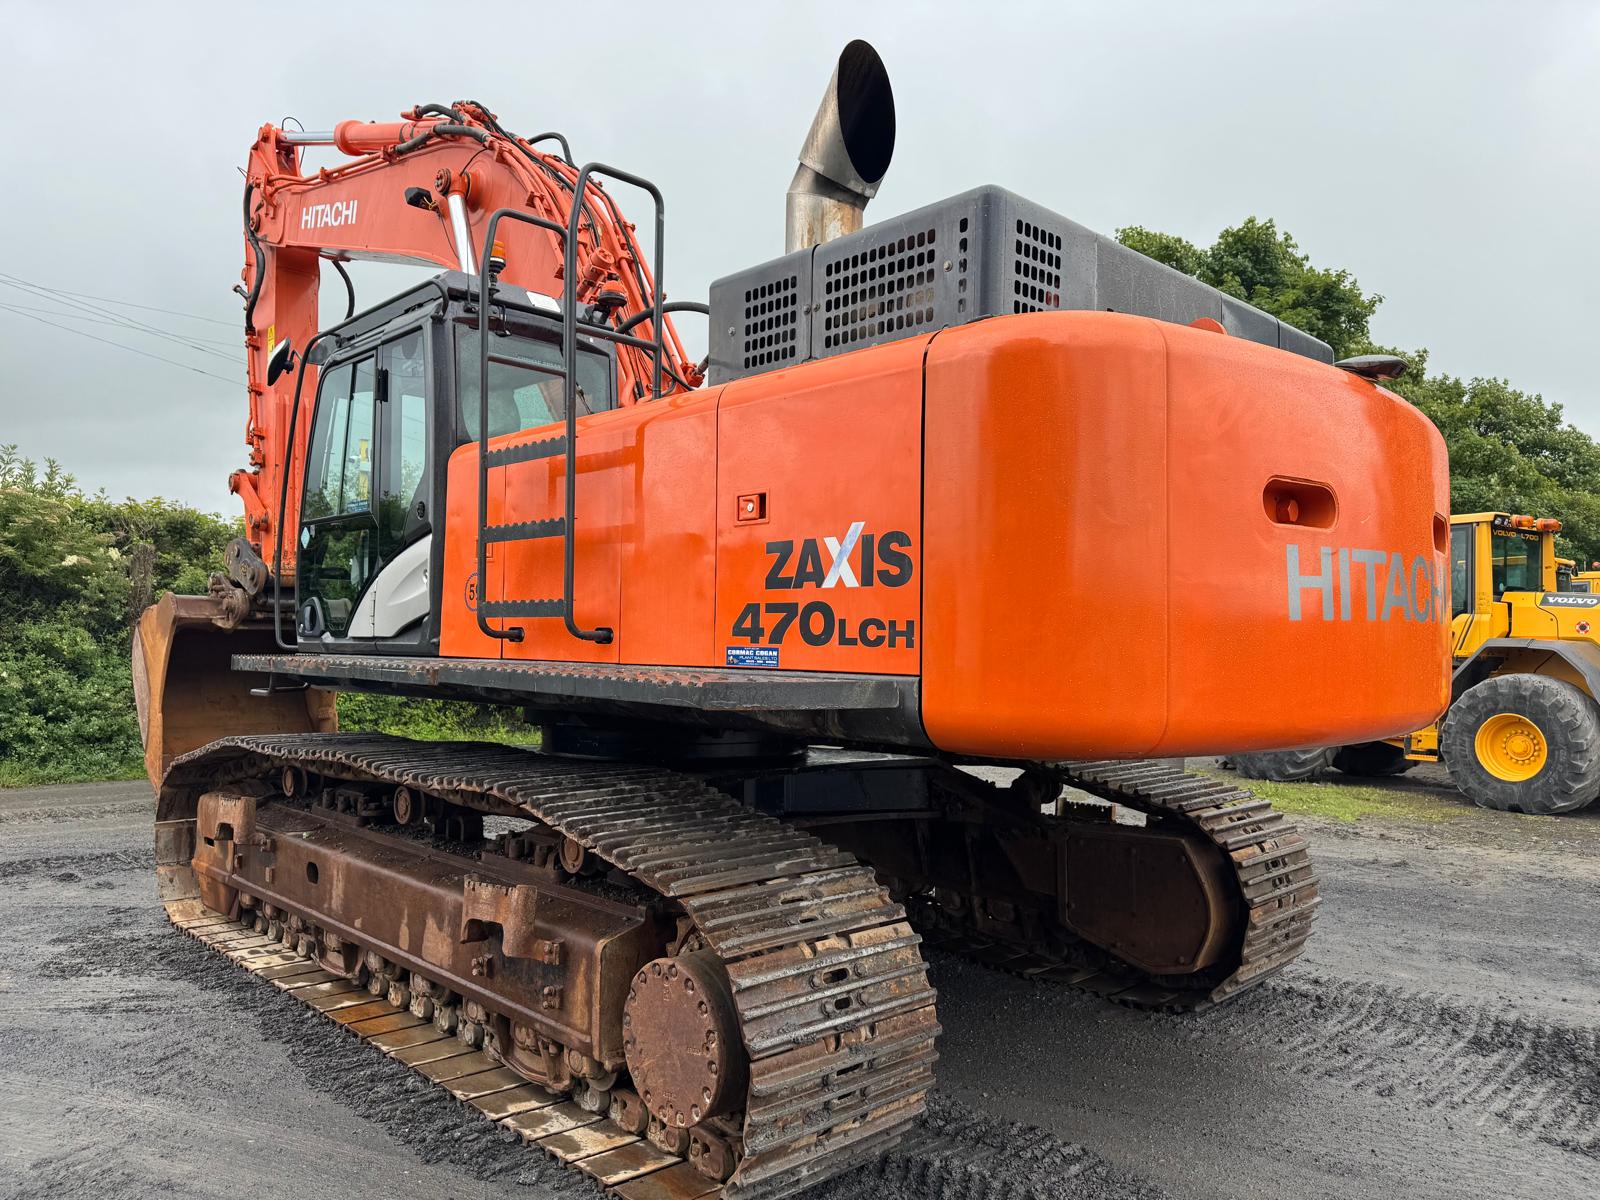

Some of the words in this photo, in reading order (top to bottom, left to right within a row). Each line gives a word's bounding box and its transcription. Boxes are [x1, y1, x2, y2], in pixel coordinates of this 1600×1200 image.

[301, 200, 357, 229] HITACHI
[1493, 529, 1517, 538] VOLVO
[765, 521, 913, 590] ZAXIS
[1286, 544, 1447, 625] HITACHI
[1546, 596, 1598, 605] VOLVO
